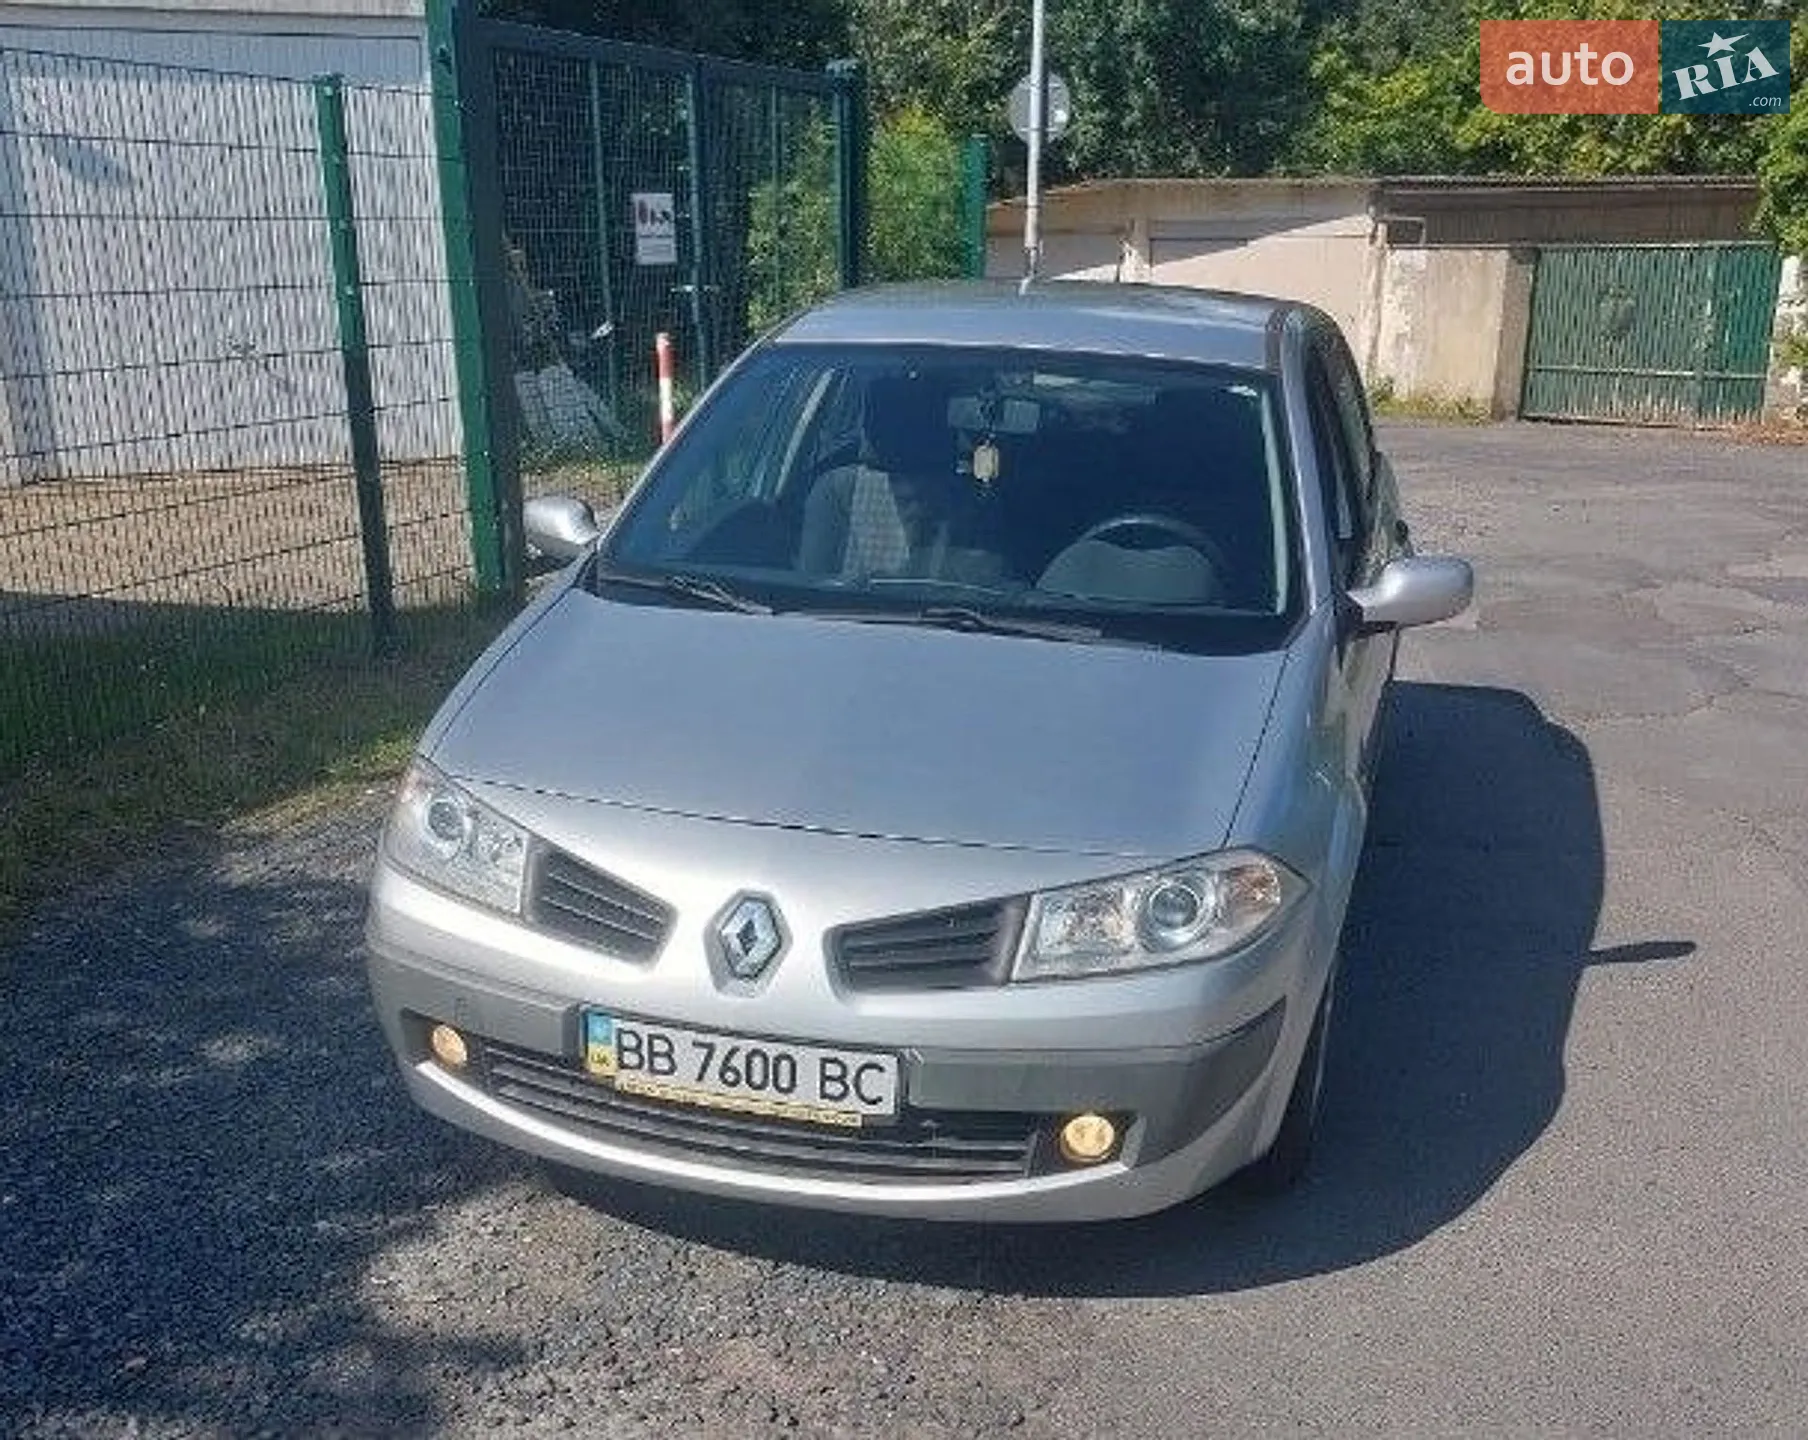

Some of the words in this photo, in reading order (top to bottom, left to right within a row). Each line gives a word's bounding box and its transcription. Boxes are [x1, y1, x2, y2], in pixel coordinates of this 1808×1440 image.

[615, 1028, 677, 1075] BB
[692, 1041, 797, 1094] 7600
[819, 1057, 886, 1105] BC
